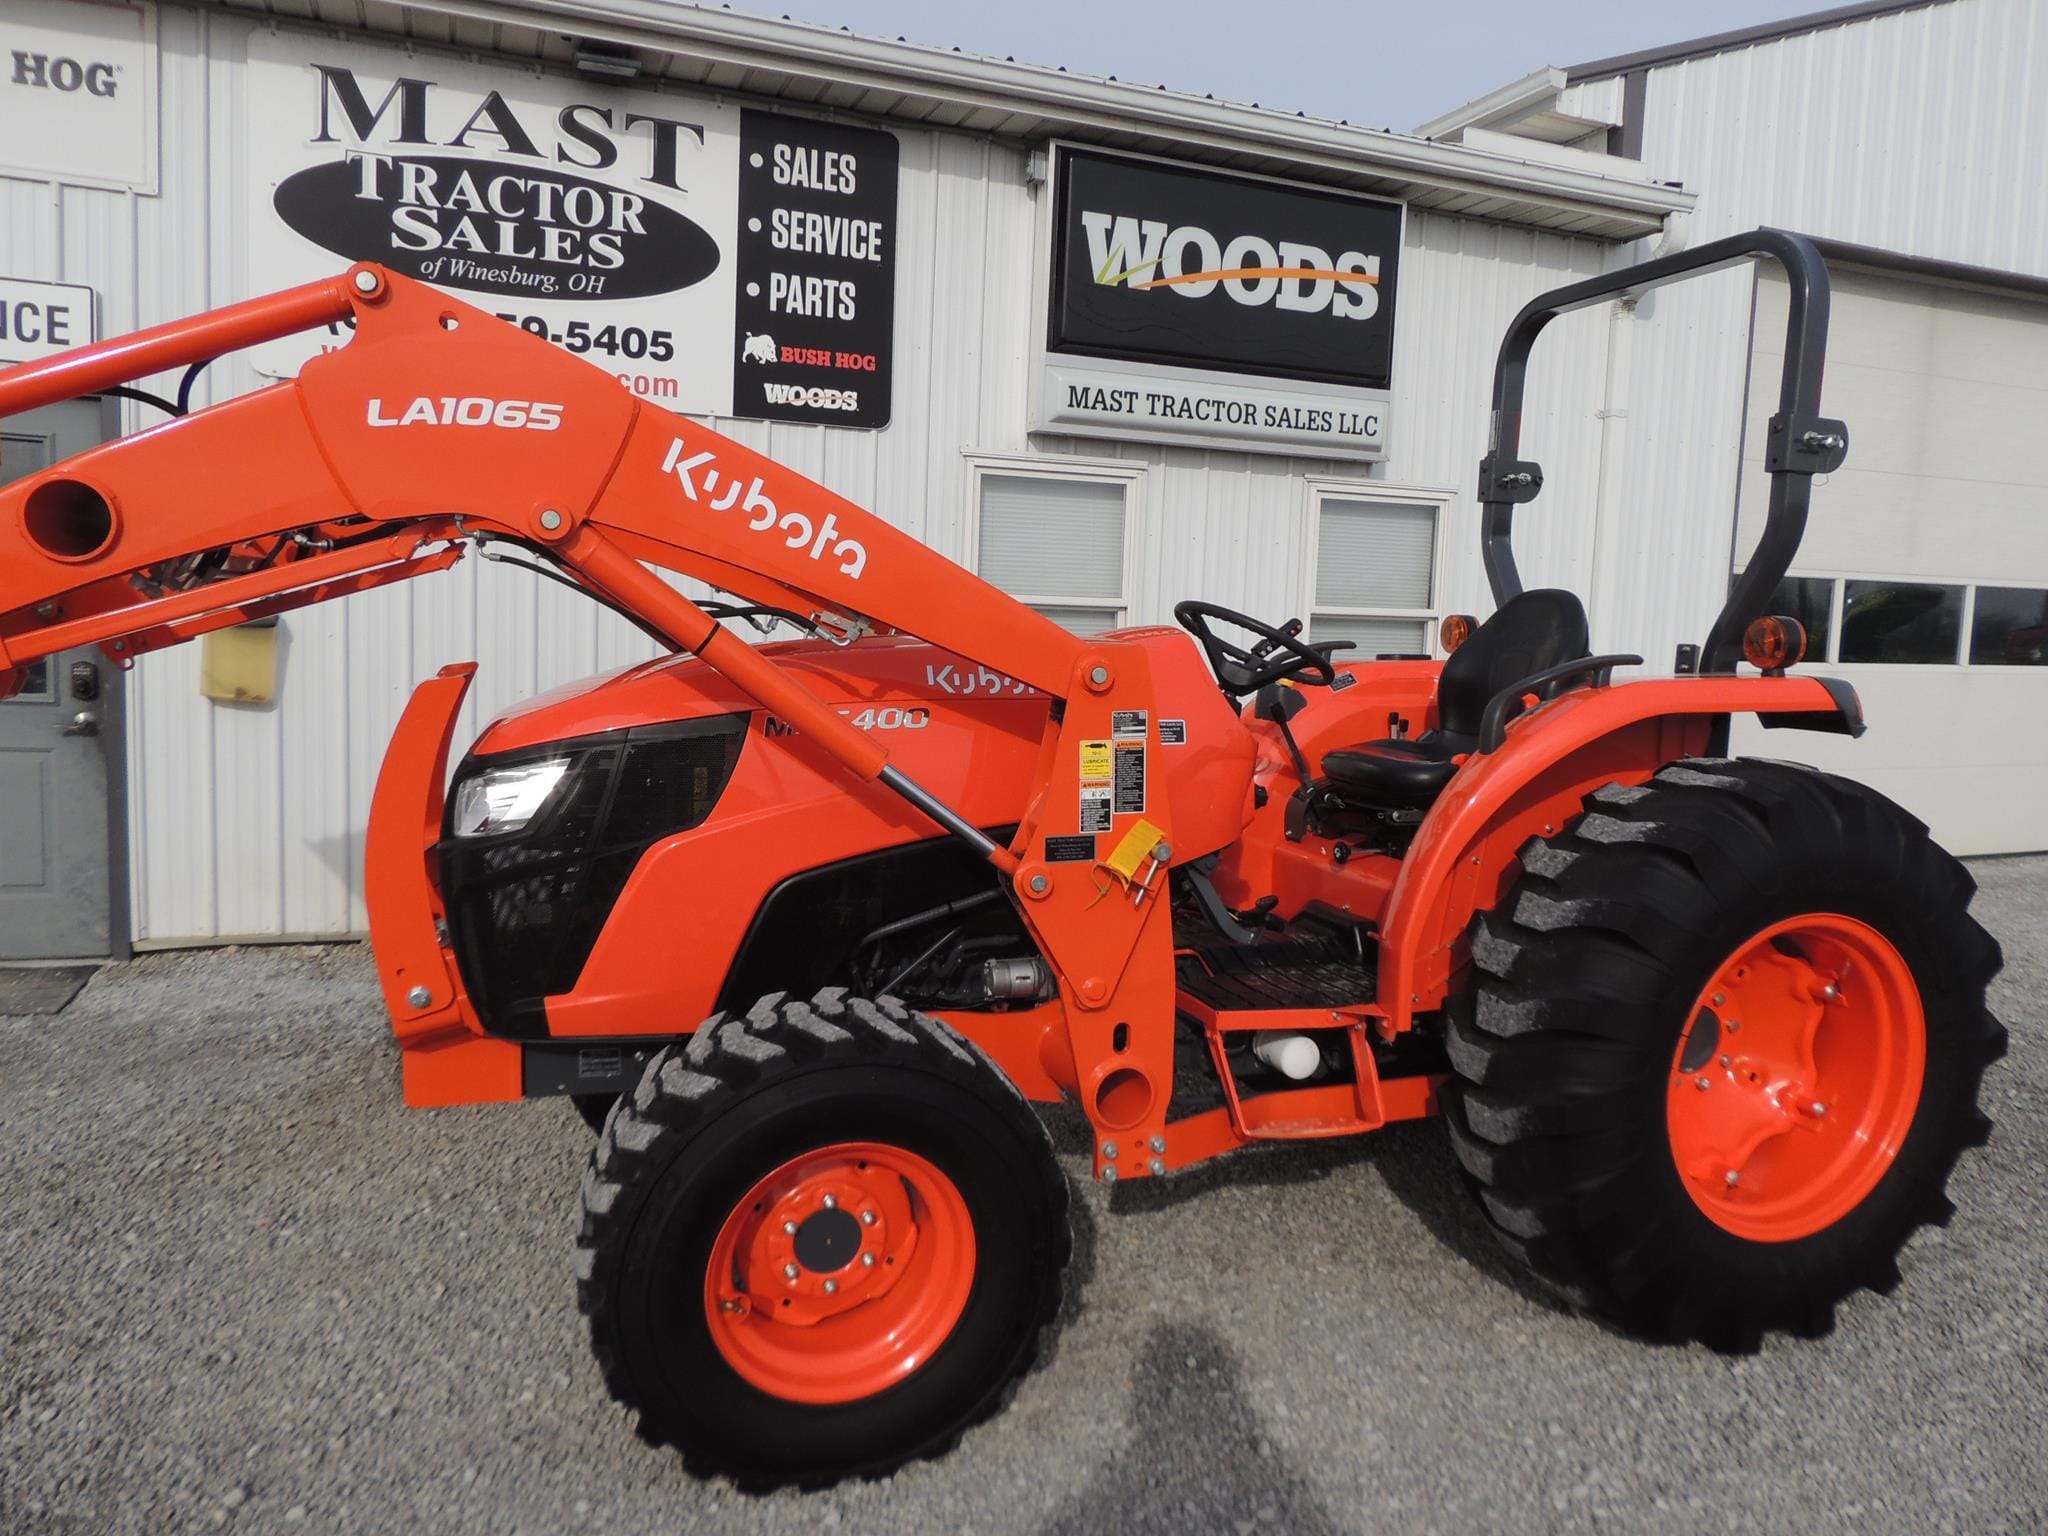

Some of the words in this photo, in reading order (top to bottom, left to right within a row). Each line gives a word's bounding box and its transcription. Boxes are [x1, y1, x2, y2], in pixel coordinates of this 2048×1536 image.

[11, 49, 117, 98] HOG
[310, 63, 704, 193] MAST
[345, 149, 648, 235] TRACTOR
[773, 143, 857, 195] SALES
[391, 205, 625, 269] SALES
[771, 208, 883, 262] SERVICE
[420, 259, 444, 280] of
[449, 259, 560, 291] Winesburg,
[568, 273, 607, 294] OH
[1082, 211, 1380, 320] WOODS
[769, 271, 856, 321] PARTS
[780, 346, 832, 368] BUSH
[835, 351, 876, 371] HOG
[366, 396, 565, 431] LA1065
[763, 383, 858, 411] WOODS
[1067, 385, 1139, 414] MAST
[1145, 393, 1258, 425] TRACTOR
[1263, 405, 1333, 433] SALES
[1338, 412, 1379, 436] LLC
[661, 437, 868, 580] Kubota
